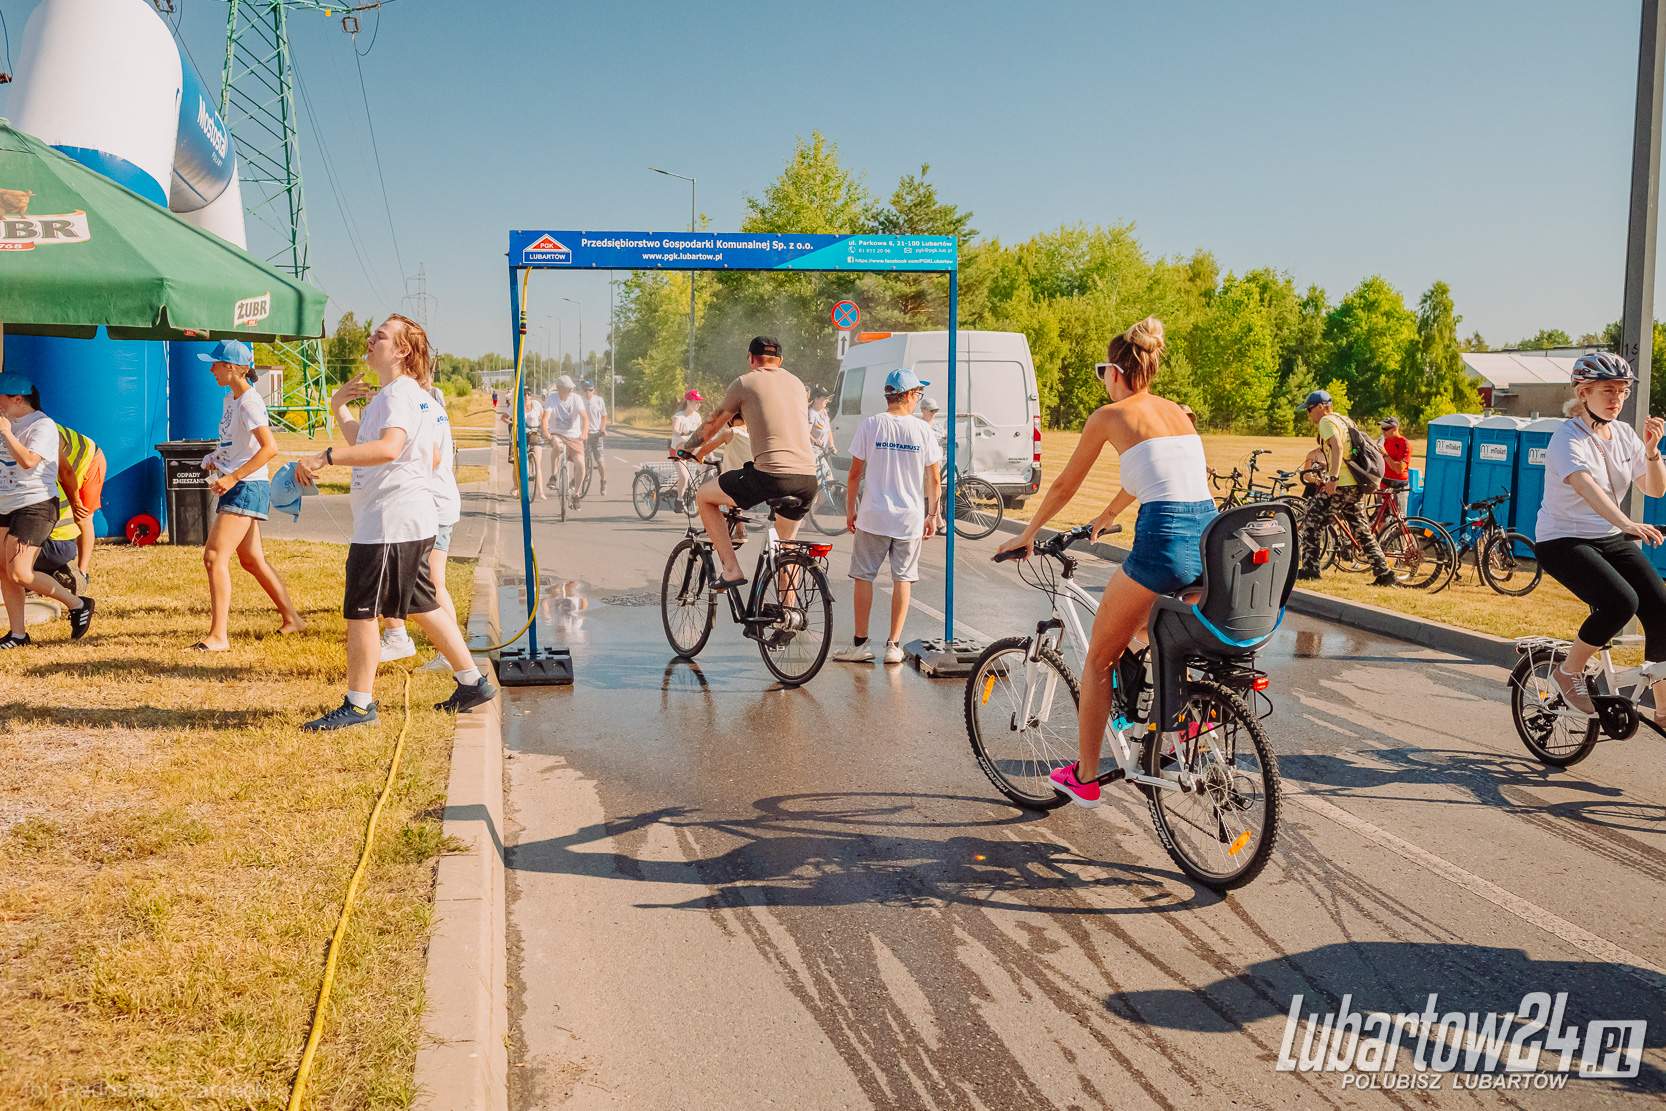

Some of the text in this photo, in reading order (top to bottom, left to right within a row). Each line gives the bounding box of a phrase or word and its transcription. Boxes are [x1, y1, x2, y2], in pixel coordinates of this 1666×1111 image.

[581, 238, 660, 249] Przedsiębiorstwo
[663, 239, 714, 250] Gospodarki
[717, 240, 770, 251] Komunalnej
[772, 241, 786, 250] Sp.
[797, 242, 813, 250] o.o.
[529, 252, 566, 260] LUBARTÓW
[642, 252, 723, 261] www.pgk.lubartow.pl
[237, 300, 267, 320] ŻUBR
